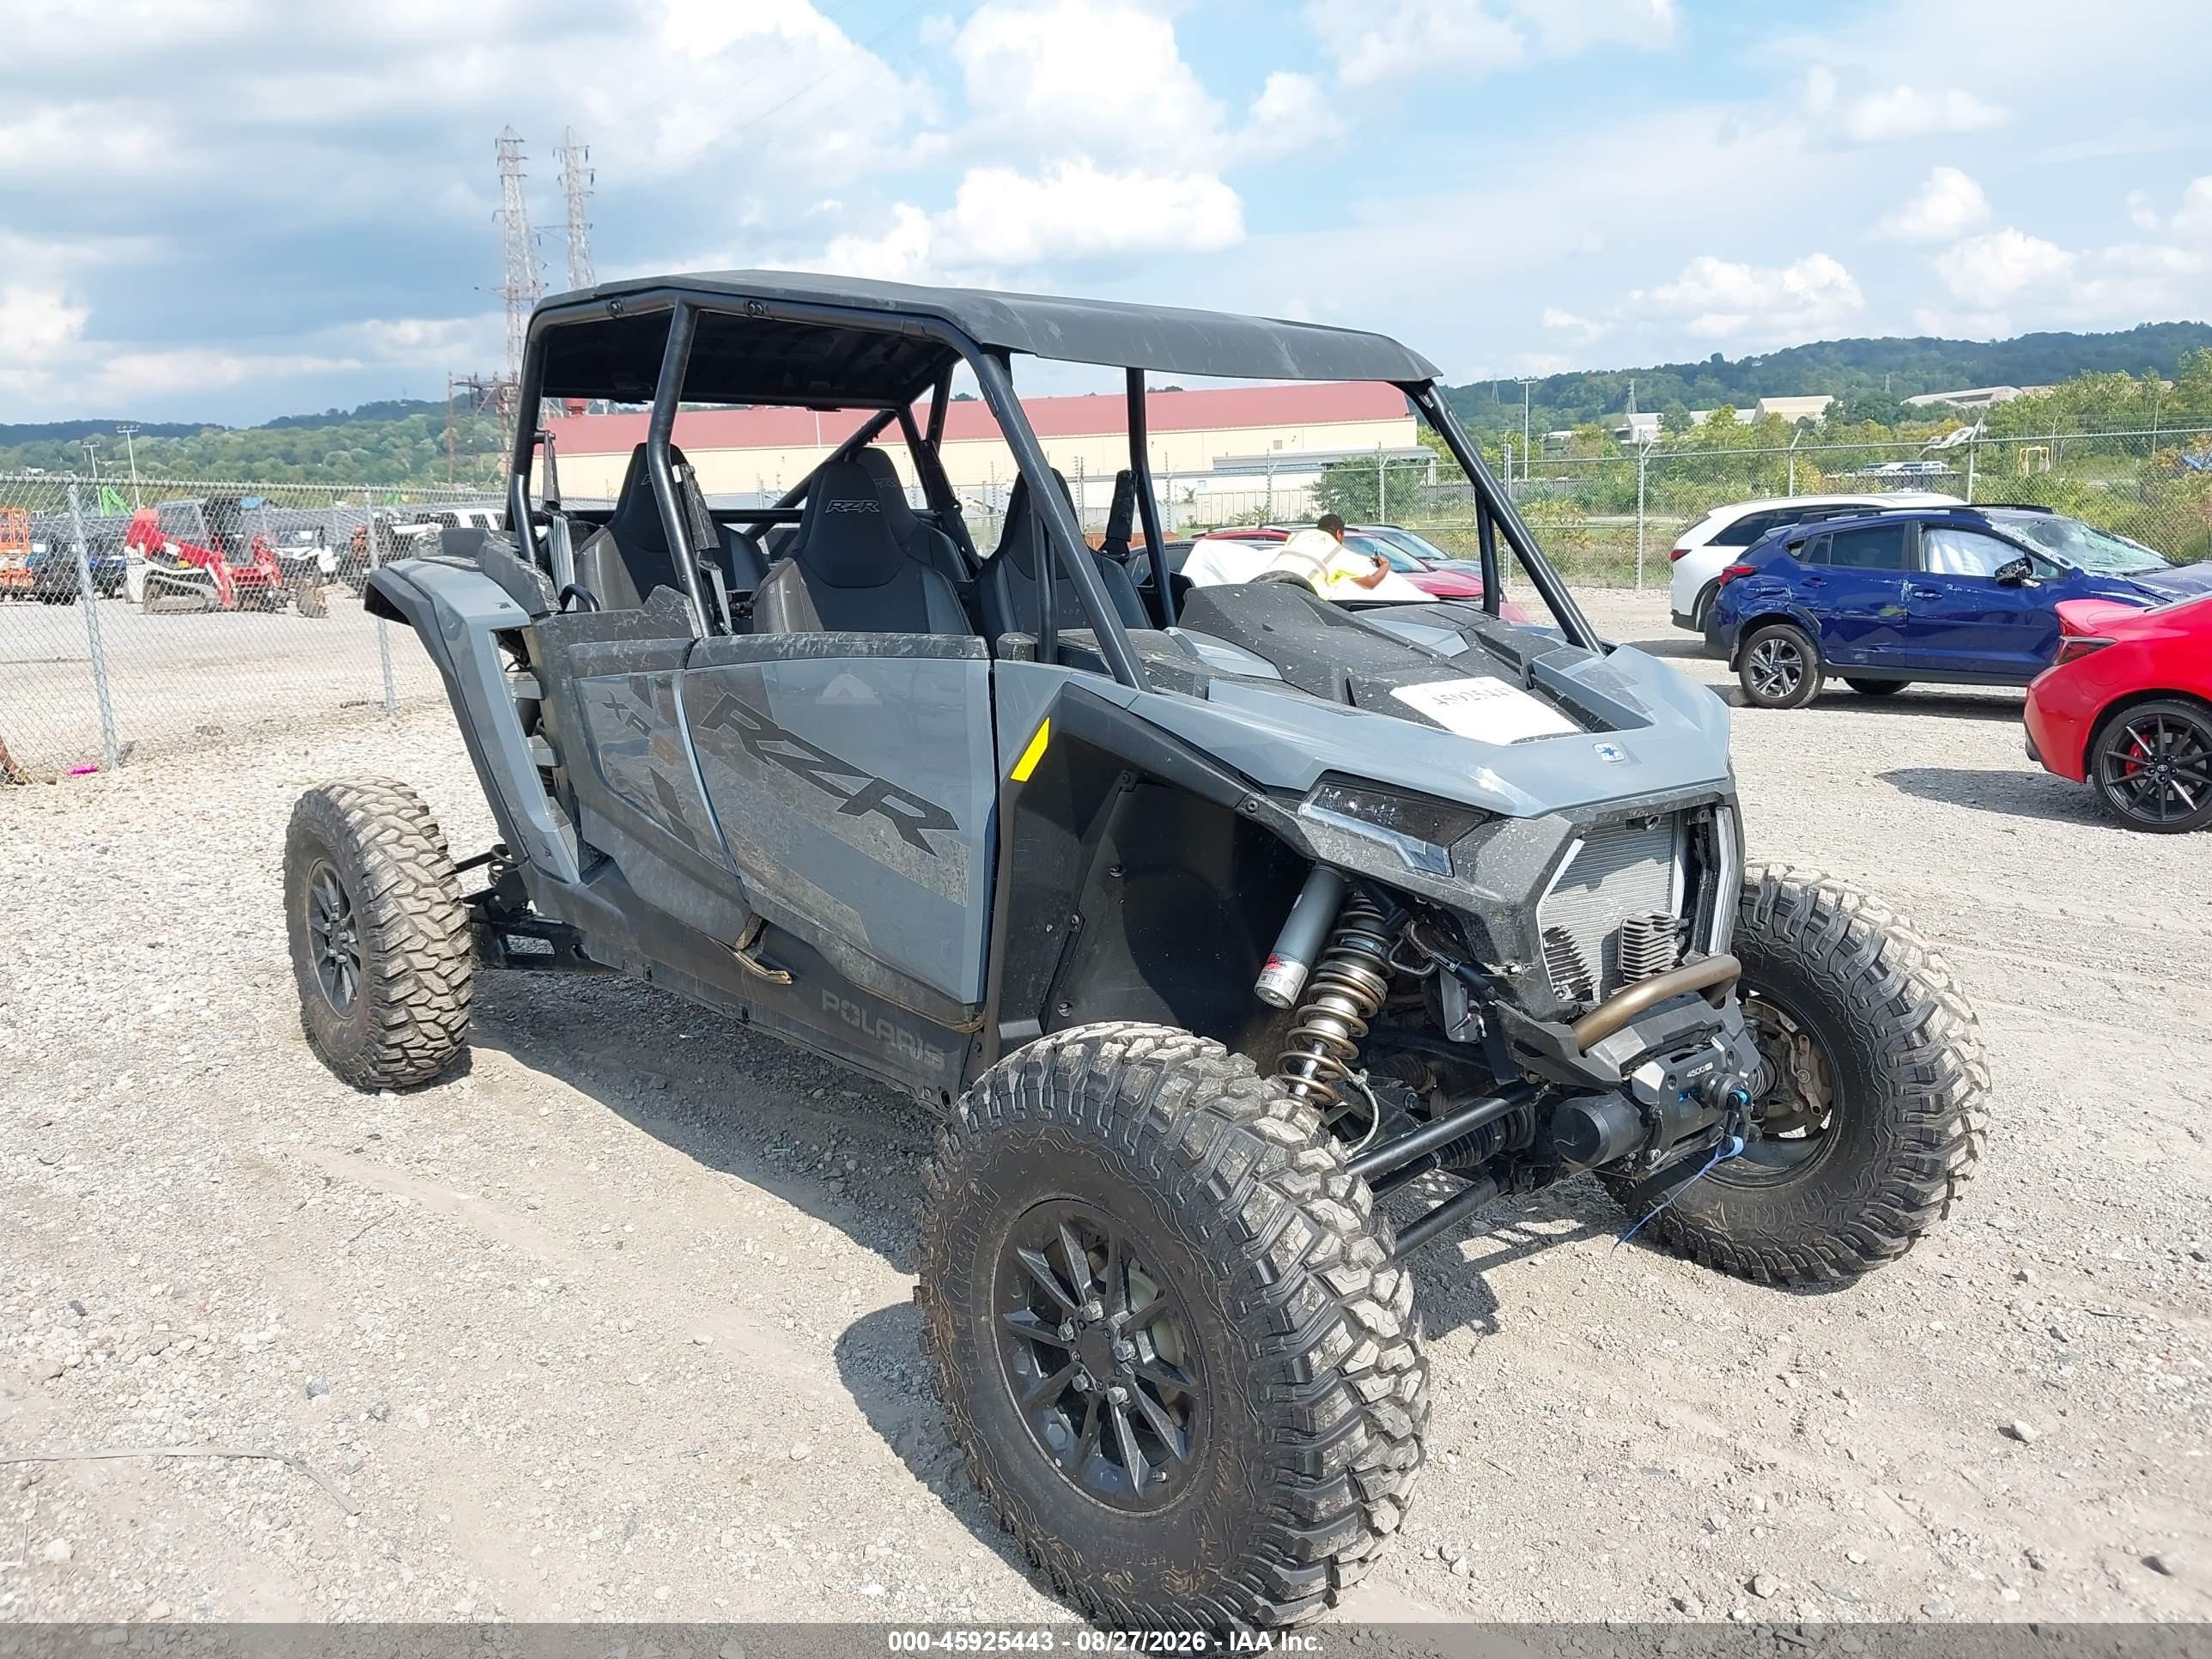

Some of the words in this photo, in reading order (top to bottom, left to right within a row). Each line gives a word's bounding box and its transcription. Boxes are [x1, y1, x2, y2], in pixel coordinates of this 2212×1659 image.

[825, 500, 880, 514] RZR
[601, 688, 653, 738] XP
[698, 691, 960, 857] RZR
[821, 988, 945, 1073] POLARIS
[1686, 1066, 1705, 1078] 4500
